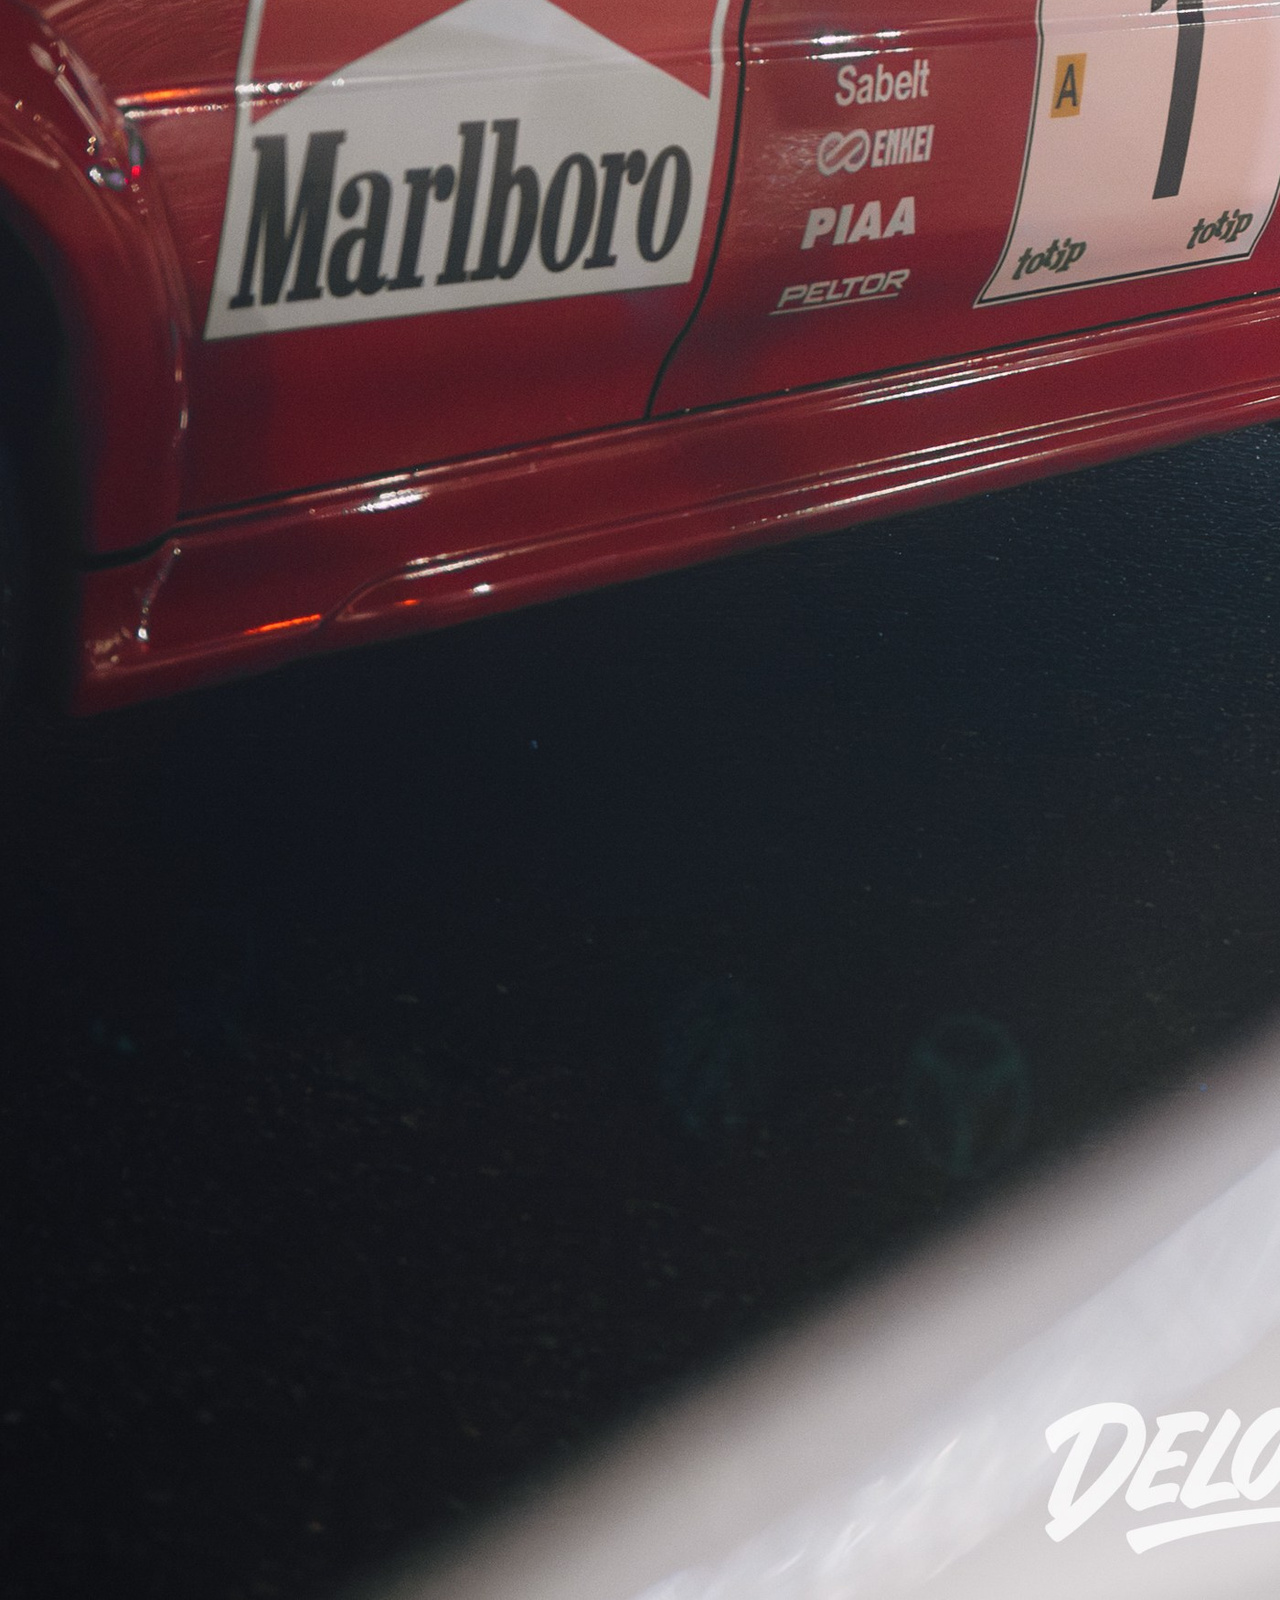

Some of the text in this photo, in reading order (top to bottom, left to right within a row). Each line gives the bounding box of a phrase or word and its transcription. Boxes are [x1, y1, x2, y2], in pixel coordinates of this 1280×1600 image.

[835, 59, 930, 106] Sabelt
[1055, 63, 1079, 109] A
[870, 124, 935, 168] ENKEI
[229, 118, 693, 311] Marlboro
[800, 196, 916, 250] PIAA
[1186, 207, 1254, 249] totip
[1011, 237, 1087, 280] totip
[776, 268, 911, 309] PELTOR
